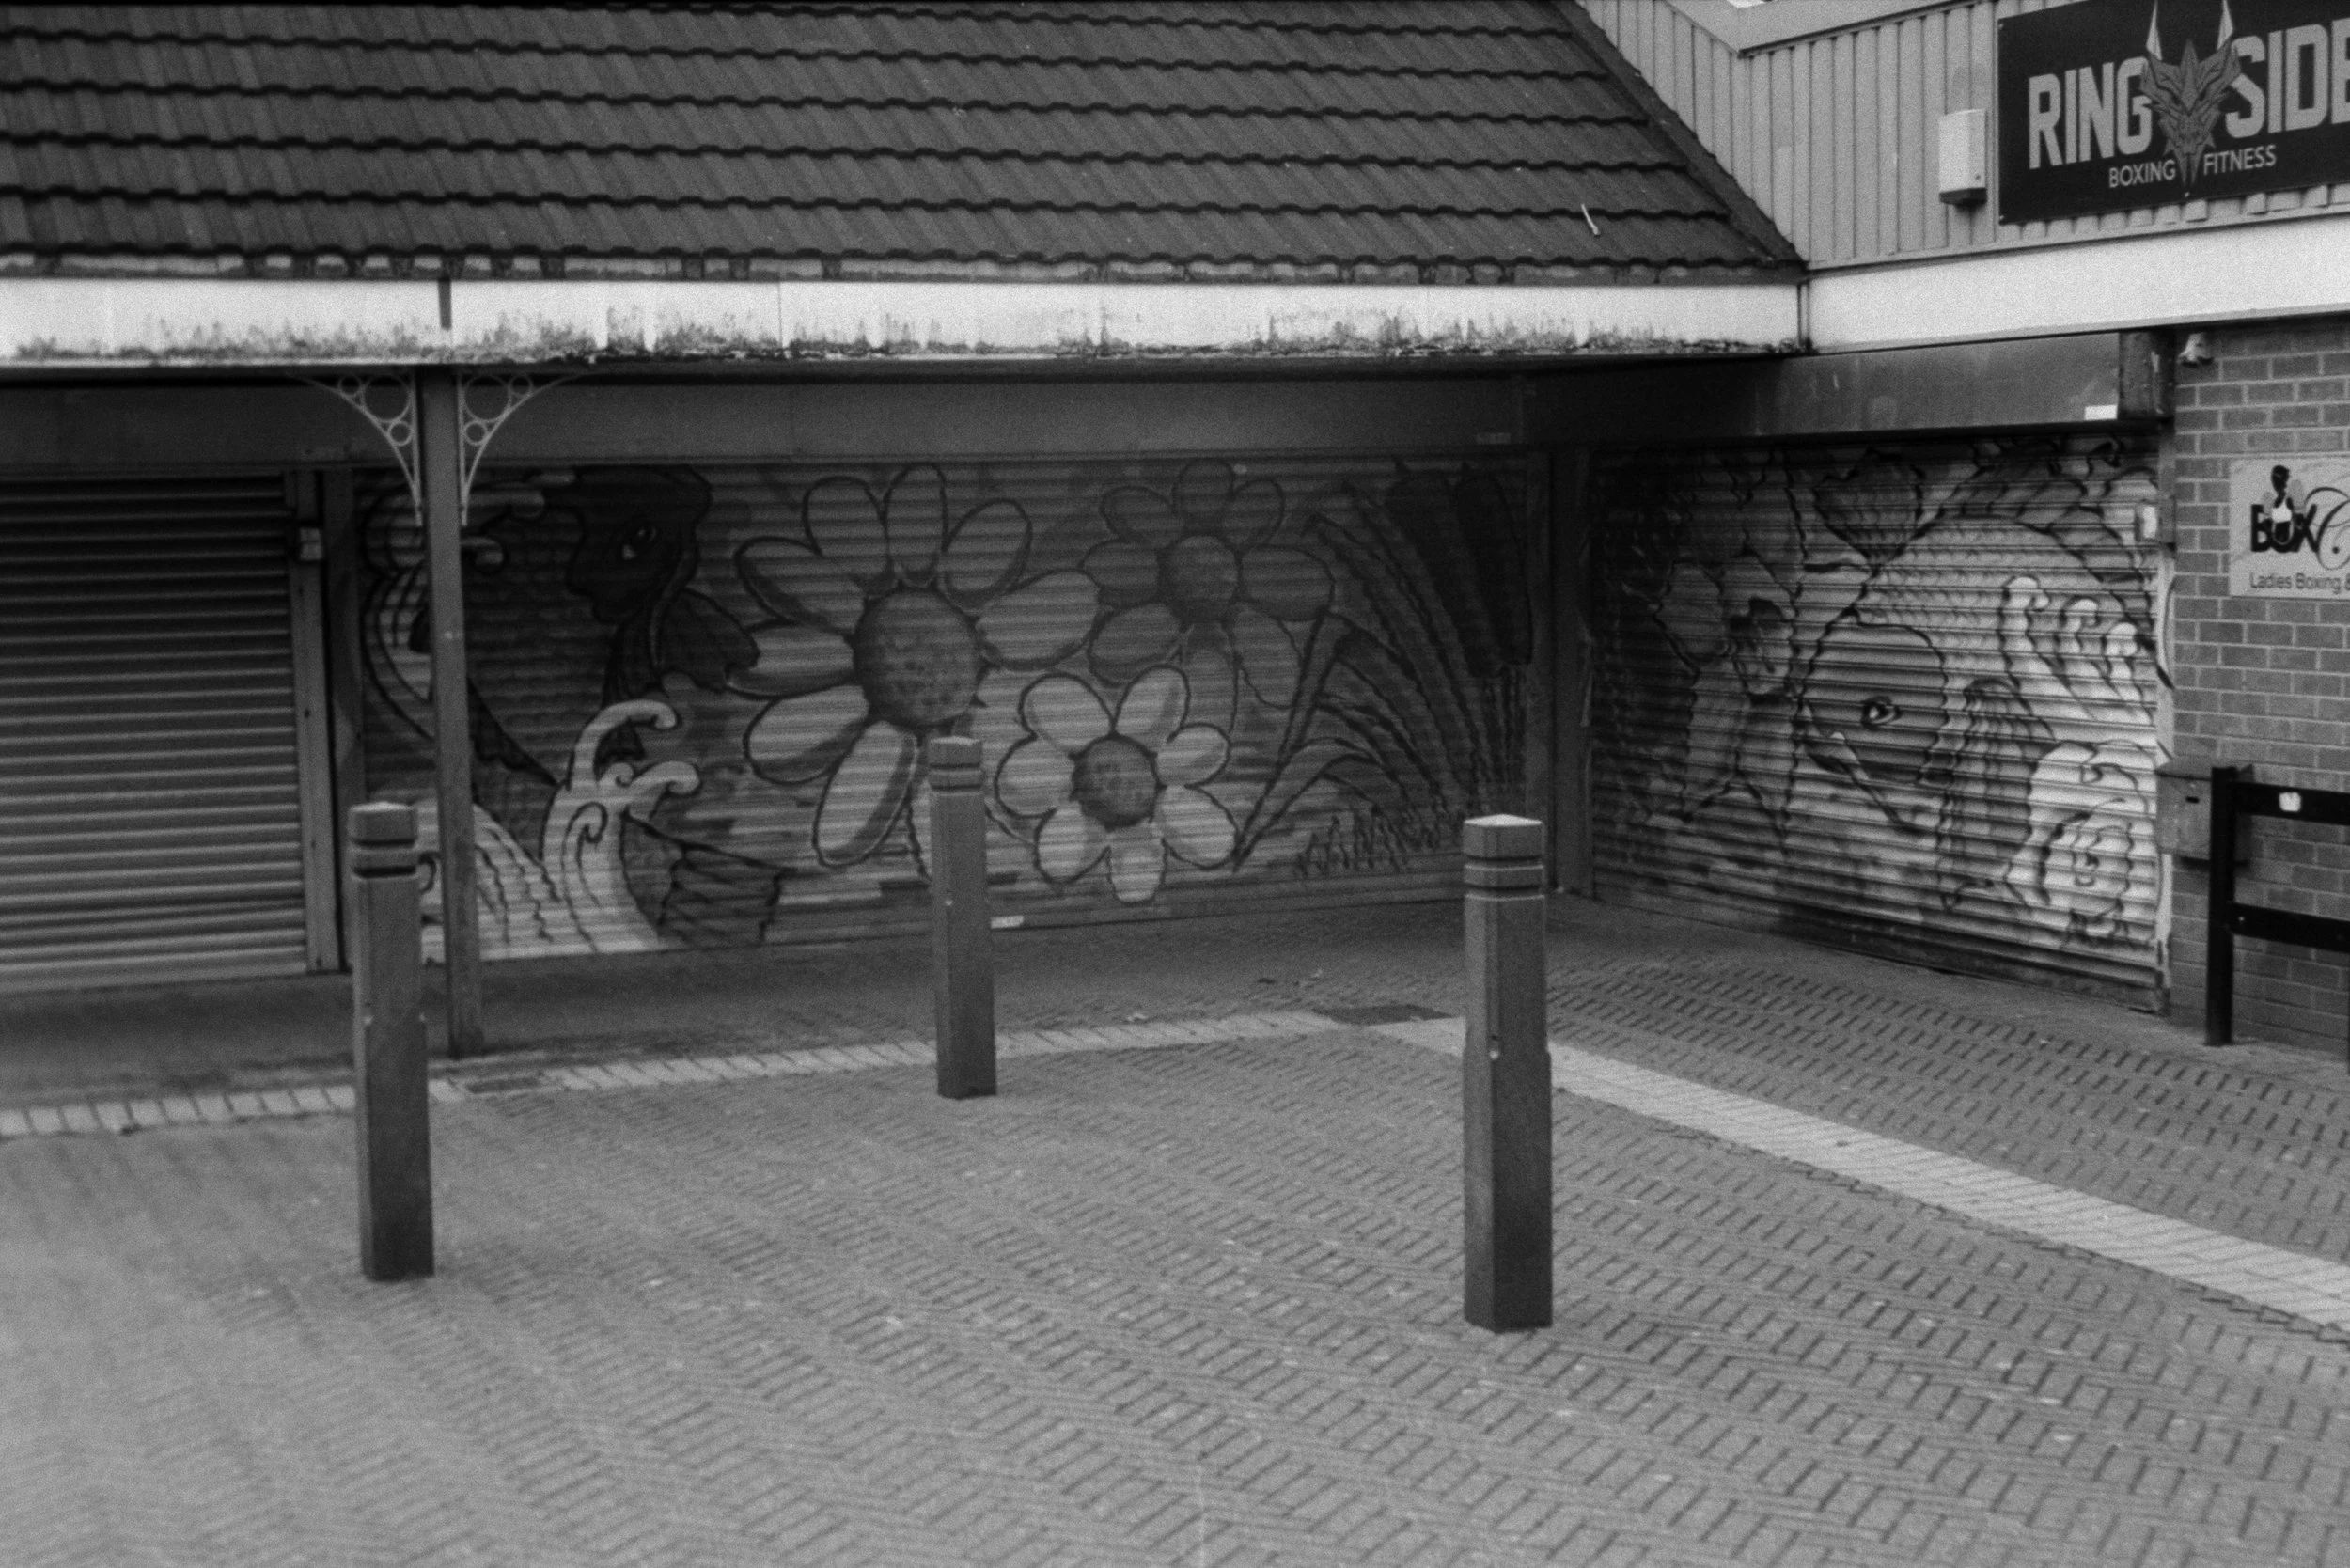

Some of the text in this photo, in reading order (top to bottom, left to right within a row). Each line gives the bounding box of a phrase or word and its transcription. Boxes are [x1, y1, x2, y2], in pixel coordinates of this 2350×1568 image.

[2029, 56, 2153, 170] RING
[2108, 144, 2278, 188] BOXING FITNESS
[2249, 572, 2292, 589] Ladies
[2295, 572, 2342, 595] Boxing
